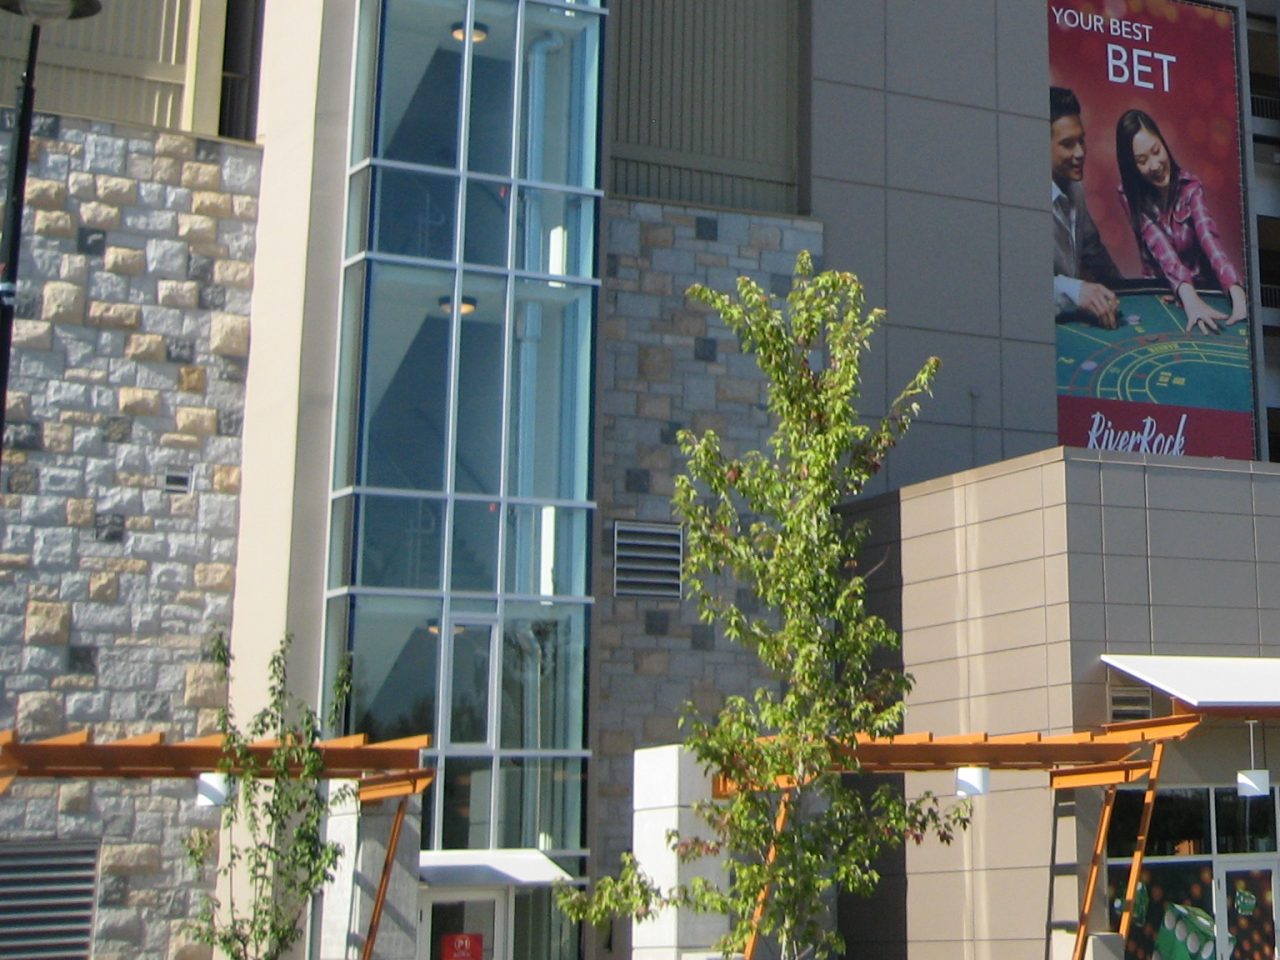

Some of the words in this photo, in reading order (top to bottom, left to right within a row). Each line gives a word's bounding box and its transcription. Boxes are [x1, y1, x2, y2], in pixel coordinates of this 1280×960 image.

[1052, 6, 1104, 33] YOUR
[1110, 18, 1153, 42] BEST
[1107, 43, 1177, 93] BET
[1087, 411, 1187, 456] RiverRock
